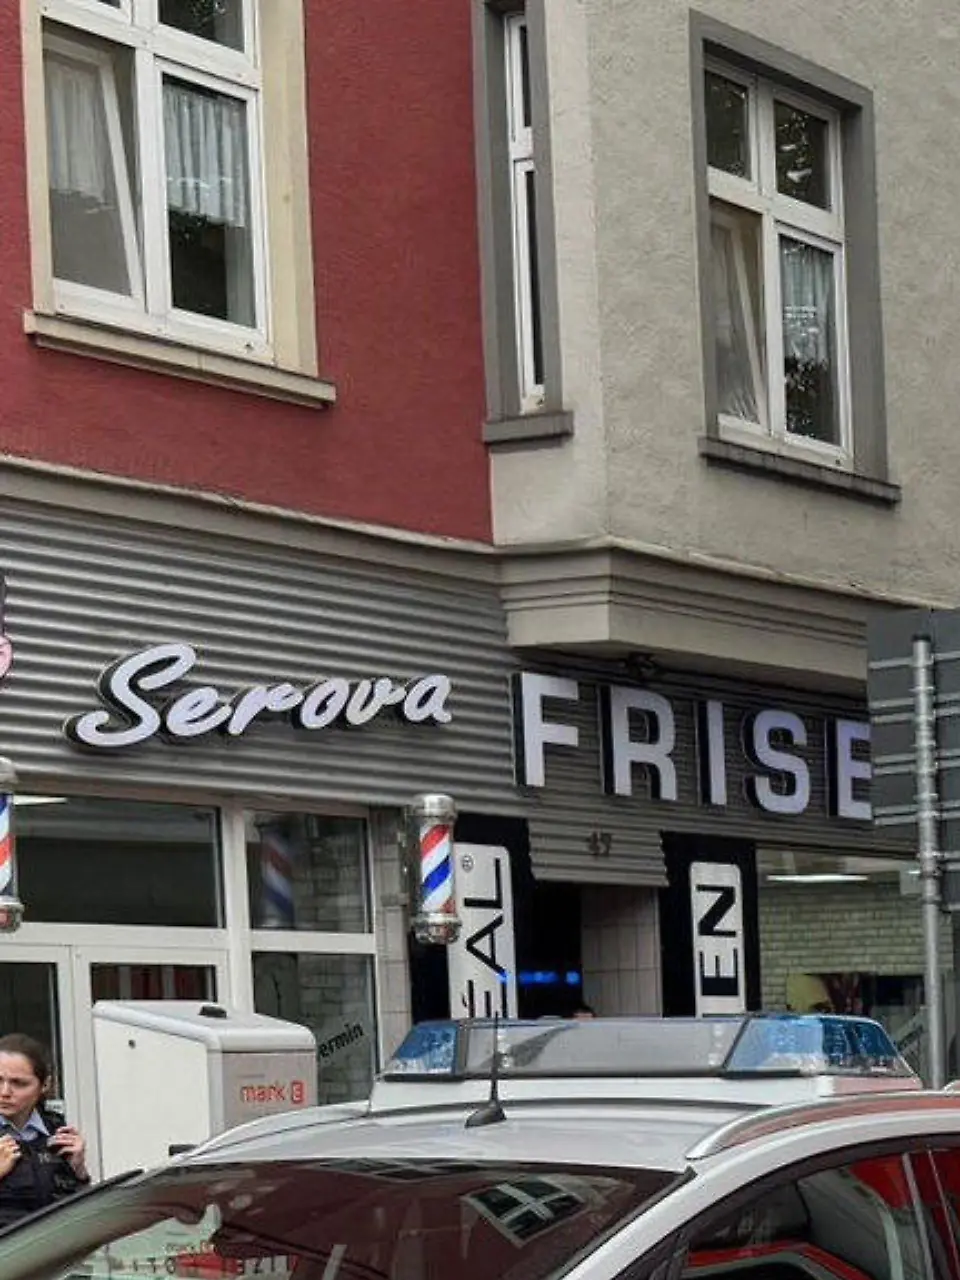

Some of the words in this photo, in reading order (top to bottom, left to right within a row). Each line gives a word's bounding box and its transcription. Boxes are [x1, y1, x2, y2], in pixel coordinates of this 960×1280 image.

[75, 642, 453, 747] Serova
[696, 884, 741, 1017] EN
[319, 1022, 365, 1058] ermin
[241, 1083, 286, 1102] mark
